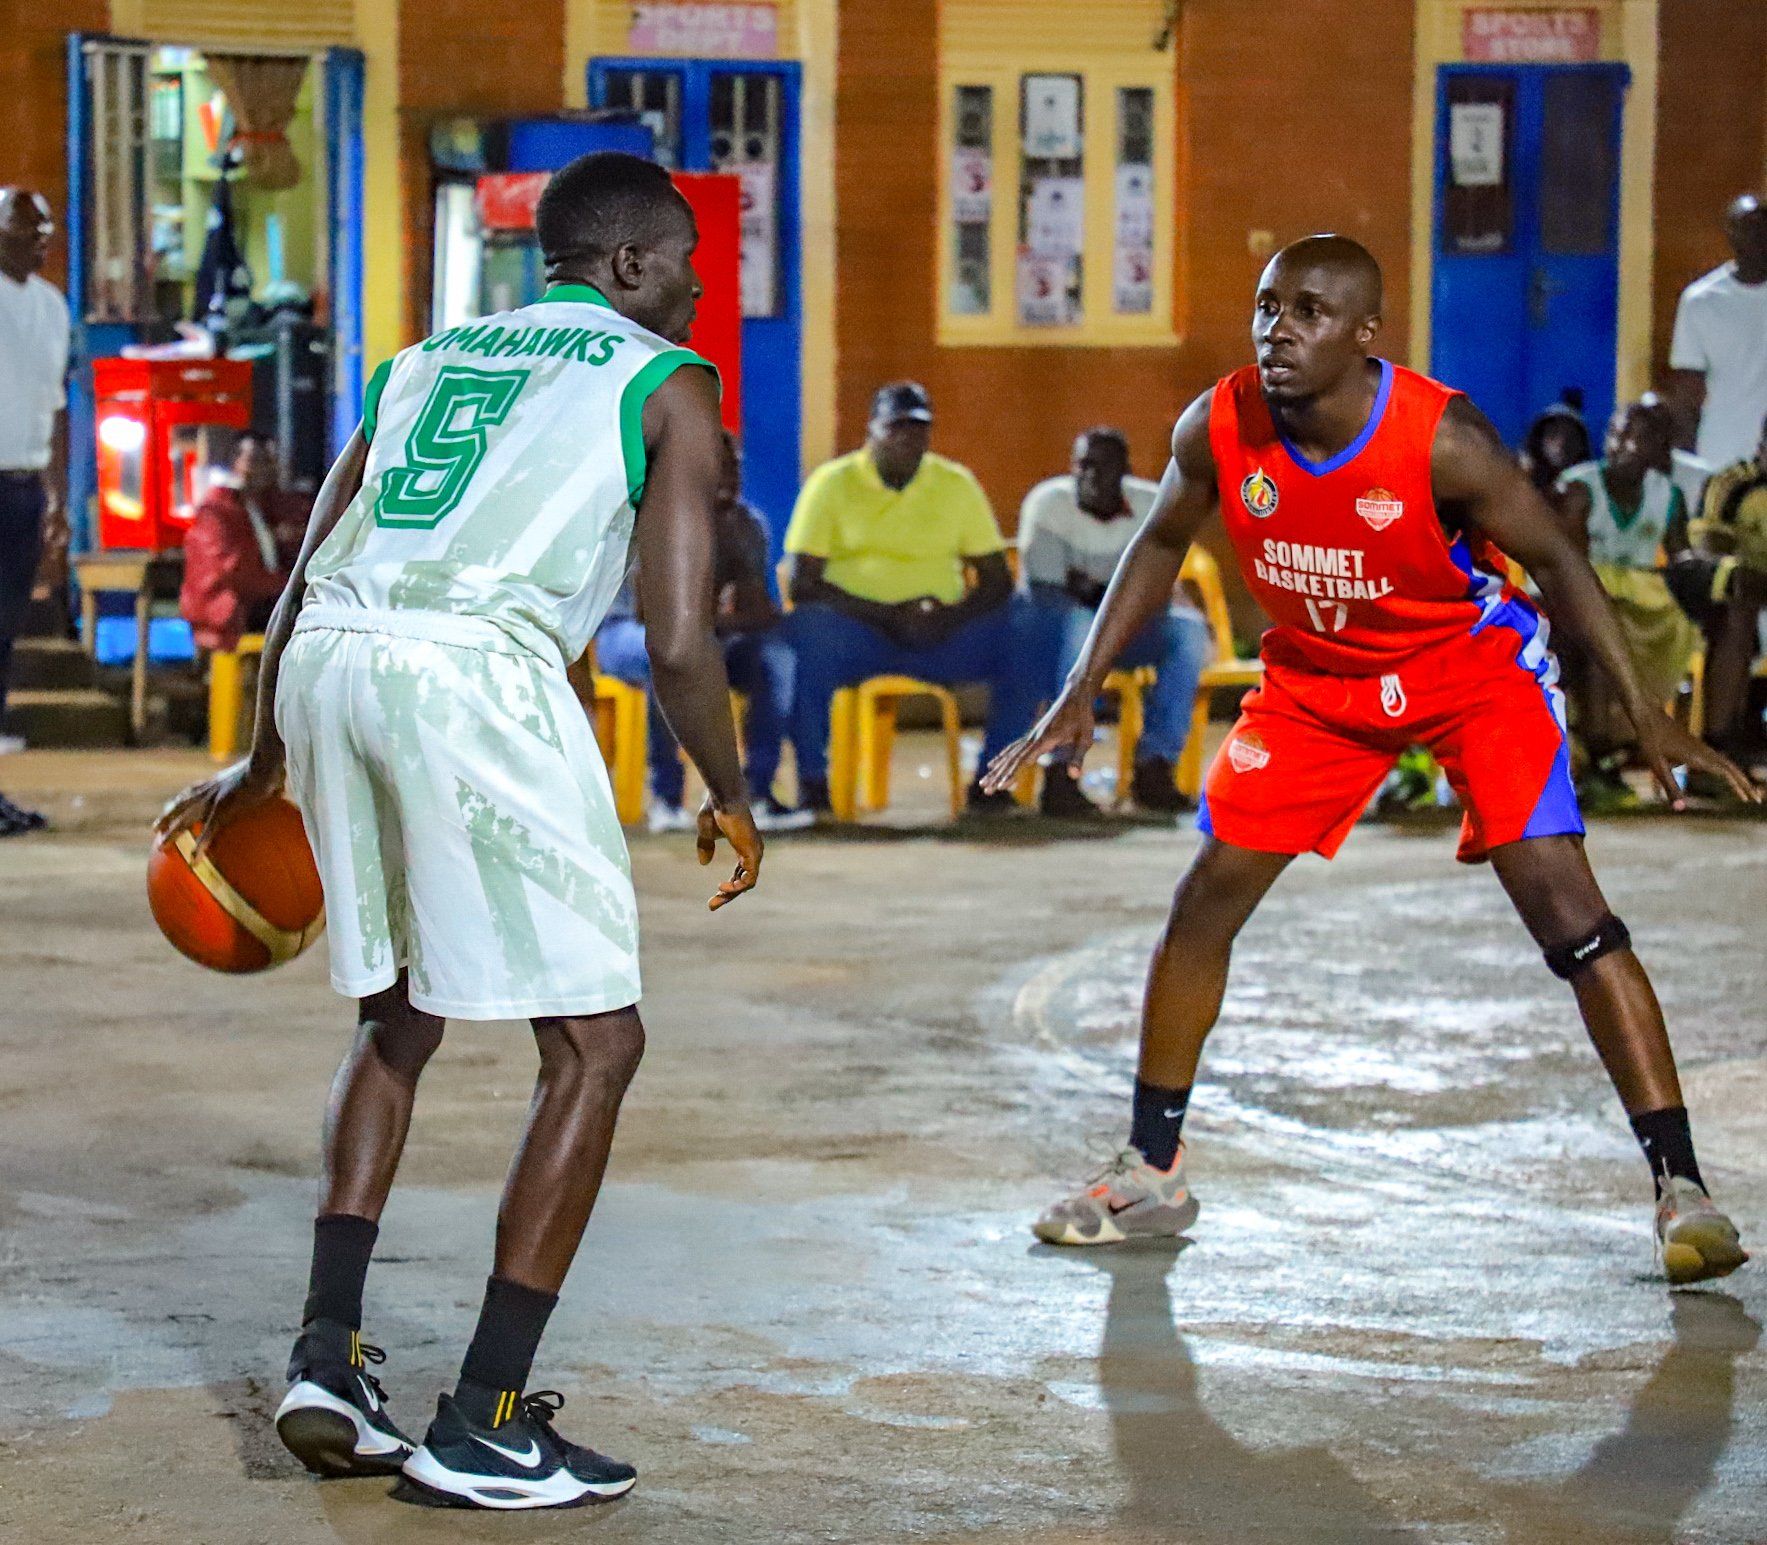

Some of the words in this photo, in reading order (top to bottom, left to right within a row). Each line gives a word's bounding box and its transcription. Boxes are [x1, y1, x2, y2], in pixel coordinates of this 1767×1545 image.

[374, 365, 531, 530] 5
[1263, 538, 1365, 578] SOMMET
[1254, 558, 1395, 600] BASKETBALL
[1305, 598, 1348, 632] 17
